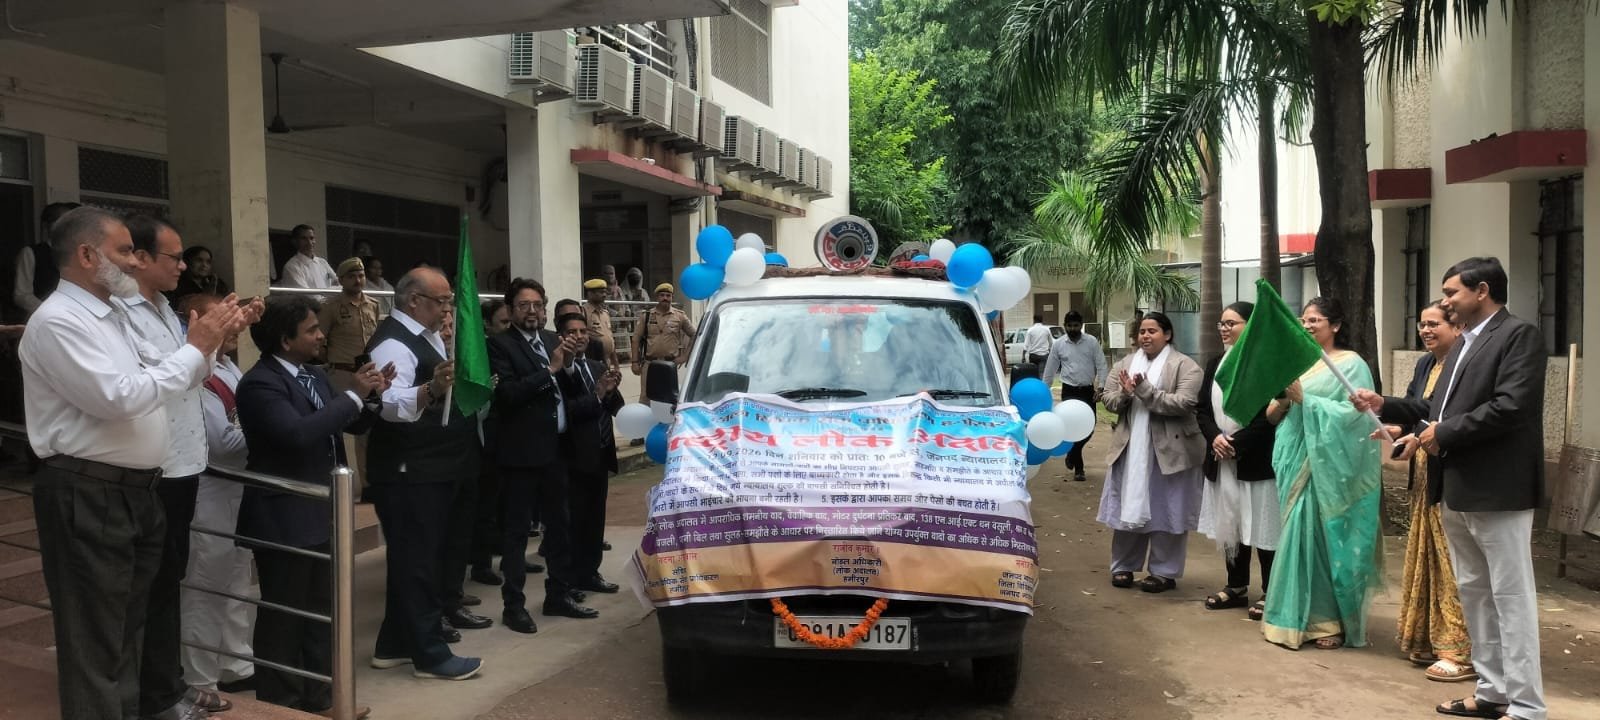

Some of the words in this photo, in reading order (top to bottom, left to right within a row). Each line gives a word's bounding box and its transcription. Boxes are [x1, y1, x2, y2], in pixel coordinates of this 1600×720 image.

[788, 451, 826, 460] शनिवार
[829, 450, 843, 460] को
[926, 450, 959, 461] जनपद
[774, 492, 791, 503] रहती
[868, 494, 892, 503] आपका
[894, 494, 912, 503] समय
[914, 492, 928, 503] और
[658, 518, 675, 530] लोक
[676, 517, 698, 528] अदालत
[742, 509, 769, 521] शमनीय
[921, 514, 933, 524] 138
[803, 525, 814, 535] पर
[884, 526, 903, 538] योग्य
[946, 533, 956, 543] का
[957, 532, 979, 546] अधिक
[980, 533, 988, 546] से
[989, 535, 1010, 548] अधिक
[843, 573, 869, 585] हमीरपुर
